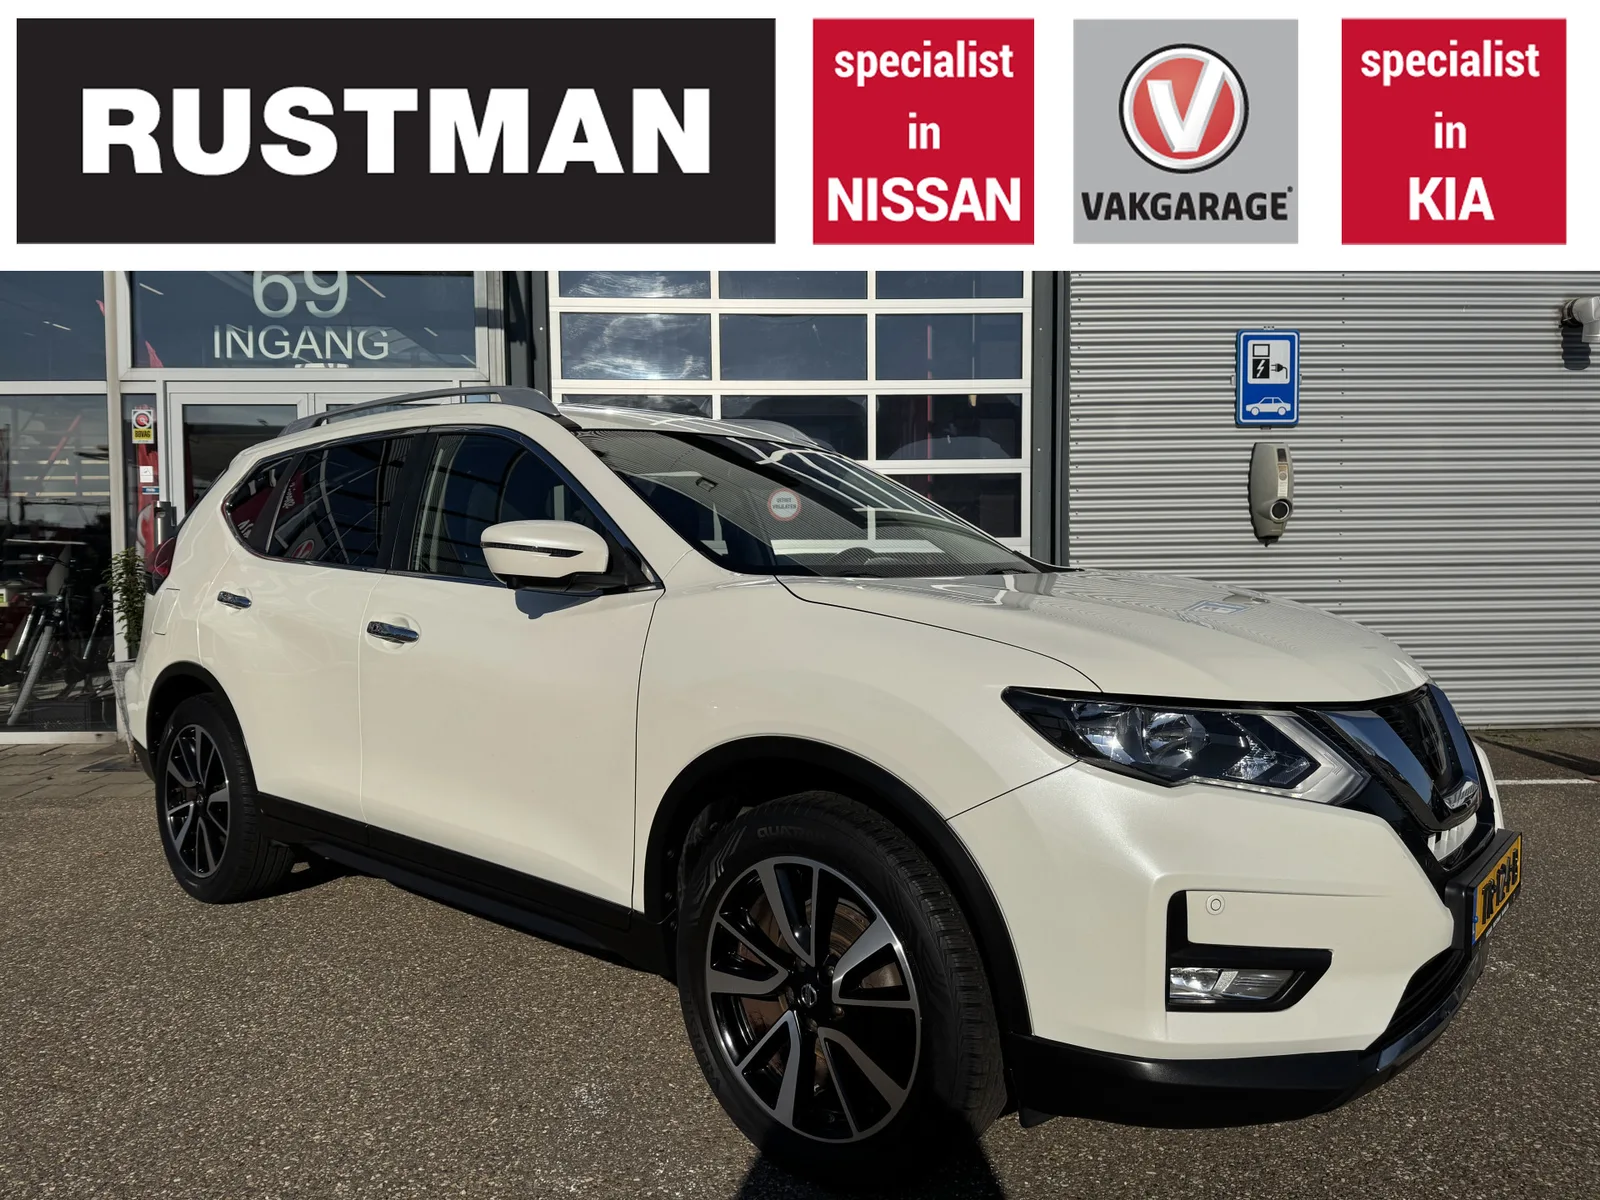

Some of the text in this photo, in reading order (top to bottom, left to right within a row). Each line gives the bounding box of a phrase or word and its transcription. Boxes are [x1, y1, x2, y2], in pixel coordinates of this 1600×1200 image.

[252, 271, 349, 318] 69
[213, 324, 389, 361] INGANG
[135, 430, 151, 438] BOVAG
